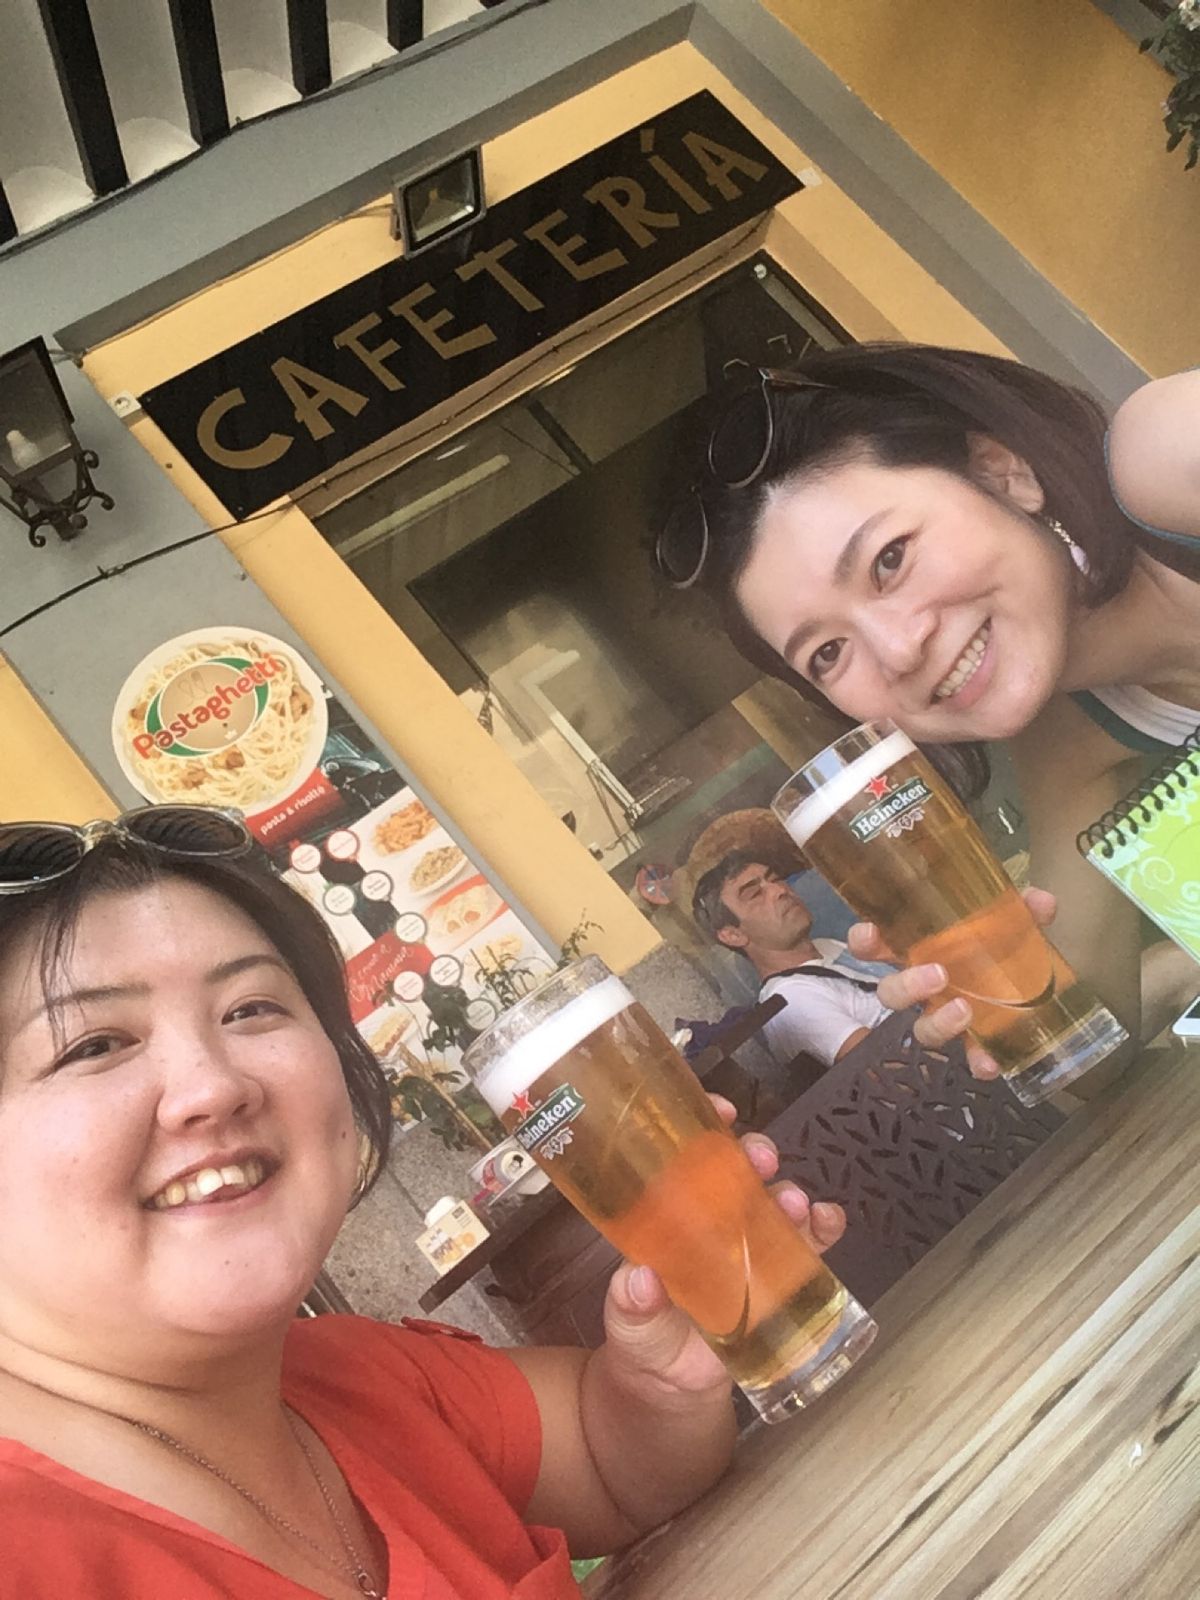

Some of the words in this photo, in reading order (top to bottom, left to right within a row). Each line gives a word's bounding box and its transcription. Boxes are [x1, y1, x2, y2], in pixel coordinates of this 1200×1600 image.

[196, 128, 770, 470] CAFETERÍA
[132, 652, 281, 760] Pastaghetti
[261, 812, 287, 837] pasta
[856, 784, 927, 836] Heineken
